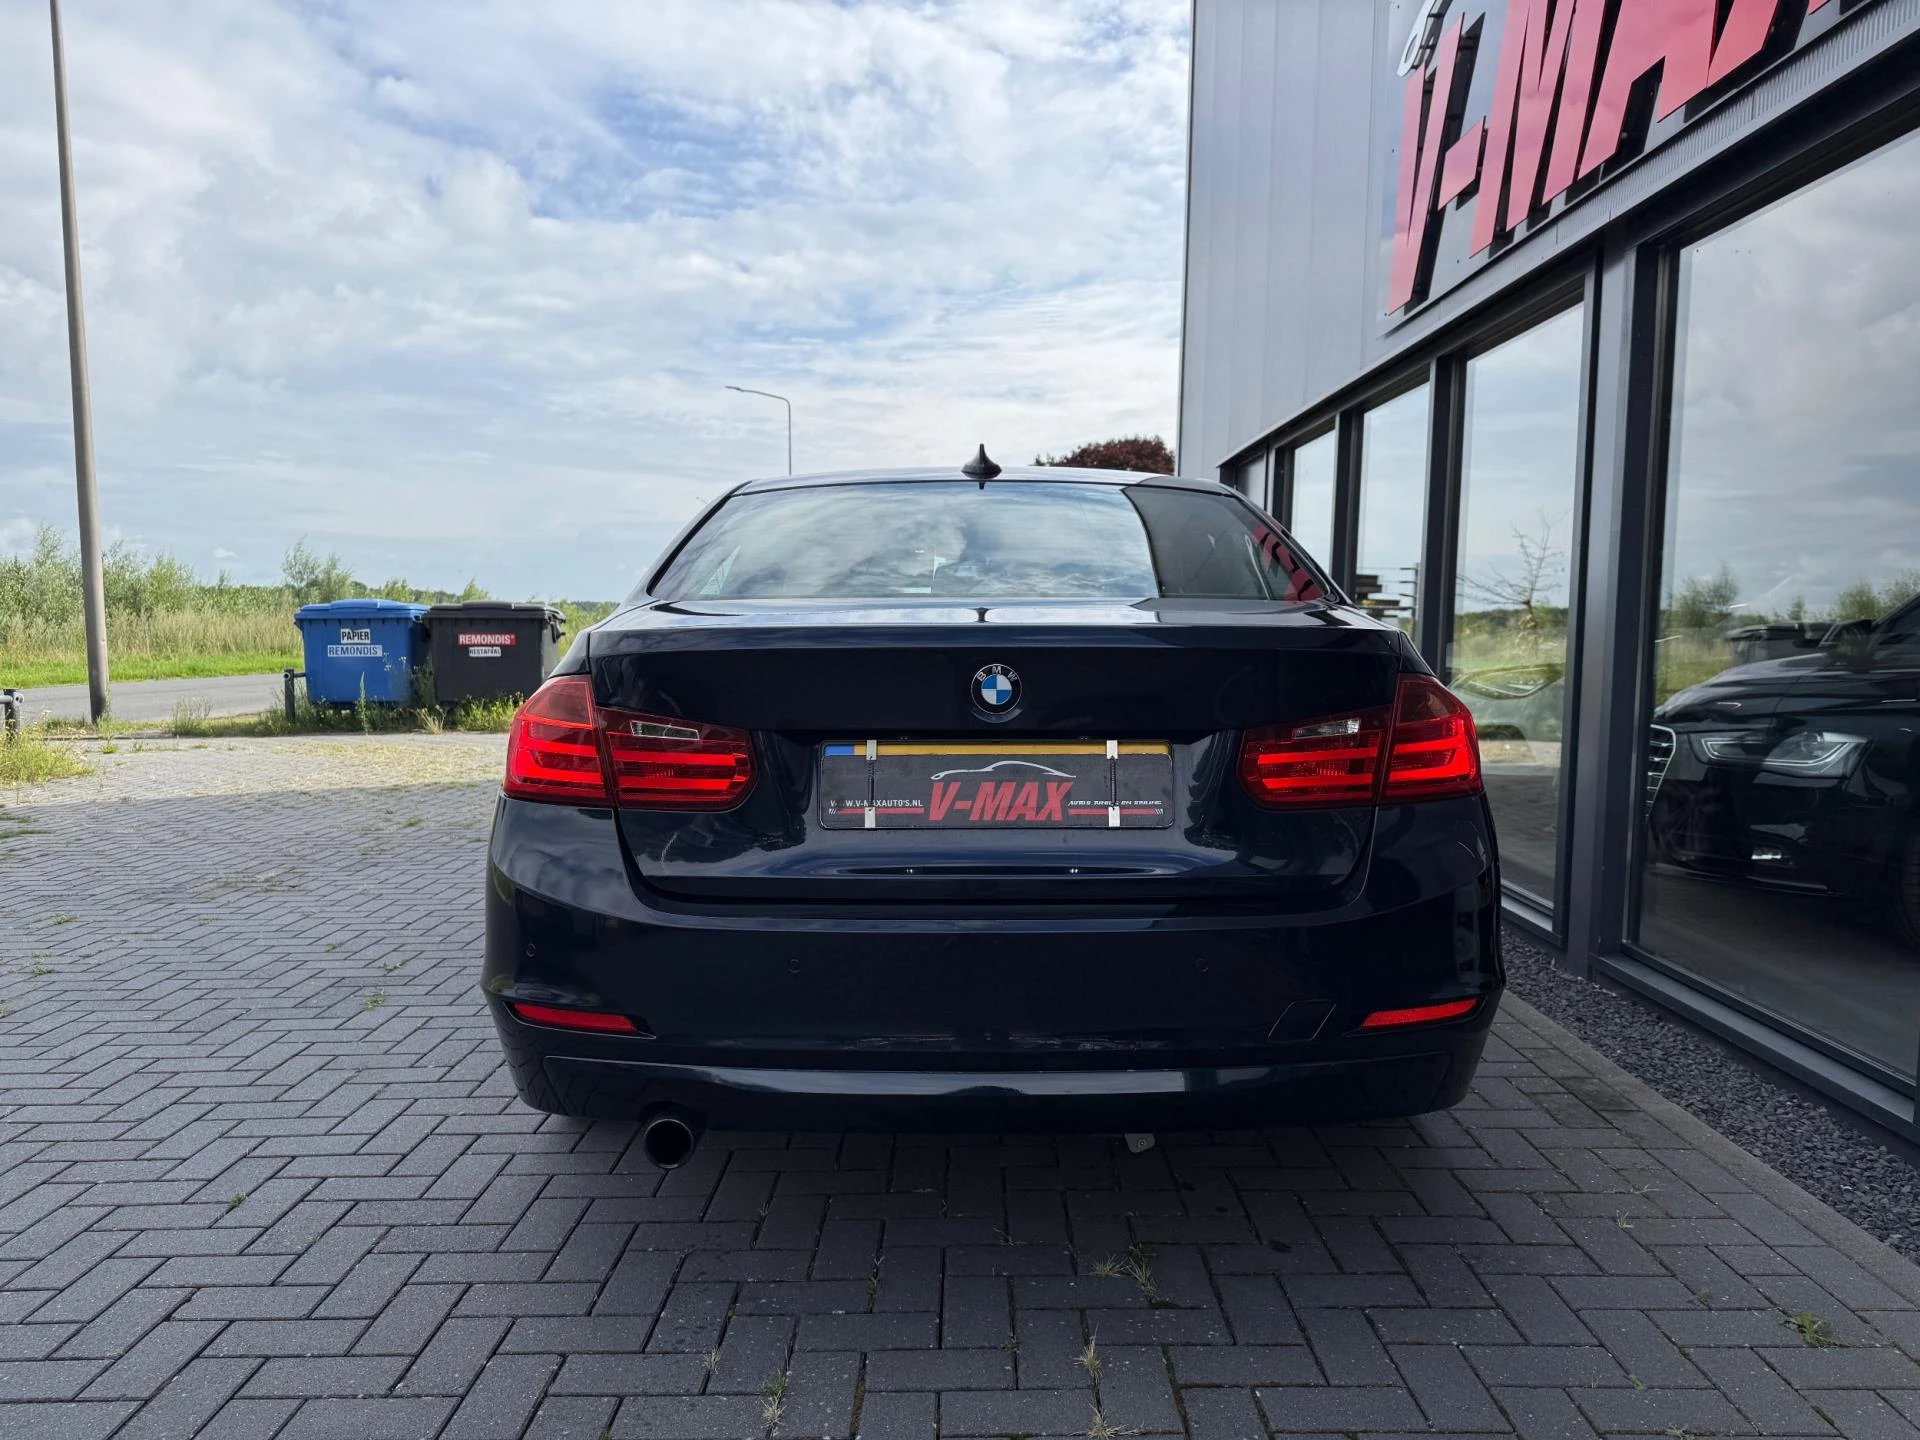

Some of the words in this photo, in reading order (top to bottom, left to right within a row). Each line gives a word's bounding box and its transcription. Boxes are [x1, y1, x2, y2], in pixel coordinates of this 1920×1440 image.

[1388, 0, 1833, 316] V-M
[341, 630, 370, 641] PAPIER
[459, 634, 511, 645] REMONDIS
[328, 646, 378, 656] REMONDIS
[976, 665, 1018, 682] BMW
[928, 781, 1073, 821] V-MAX
